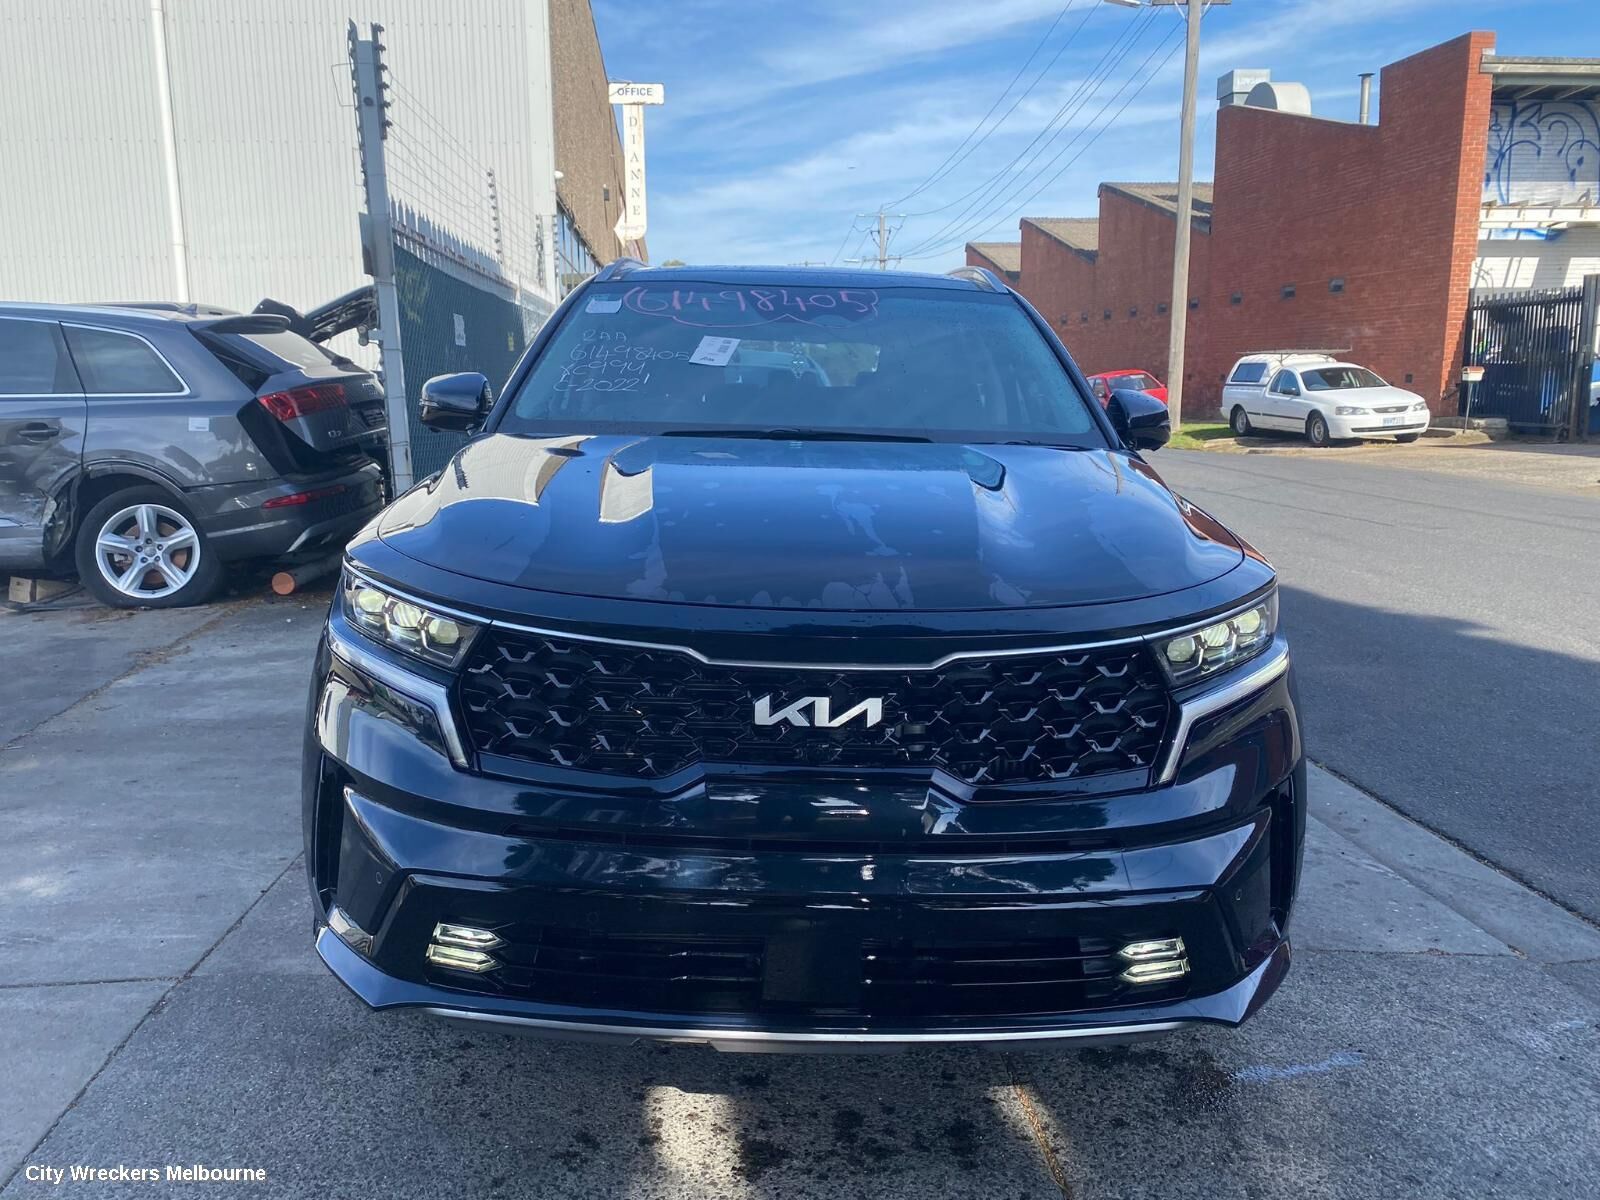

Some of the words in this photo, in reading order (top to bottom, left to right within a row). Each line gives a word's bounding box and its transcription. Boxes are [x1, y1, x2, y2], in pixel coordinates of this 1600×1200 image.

[617, 87, 653, 96] OFFICE
[629, 115, 641, 216] DIANNE
[754, 695, 882, 728] KIA
